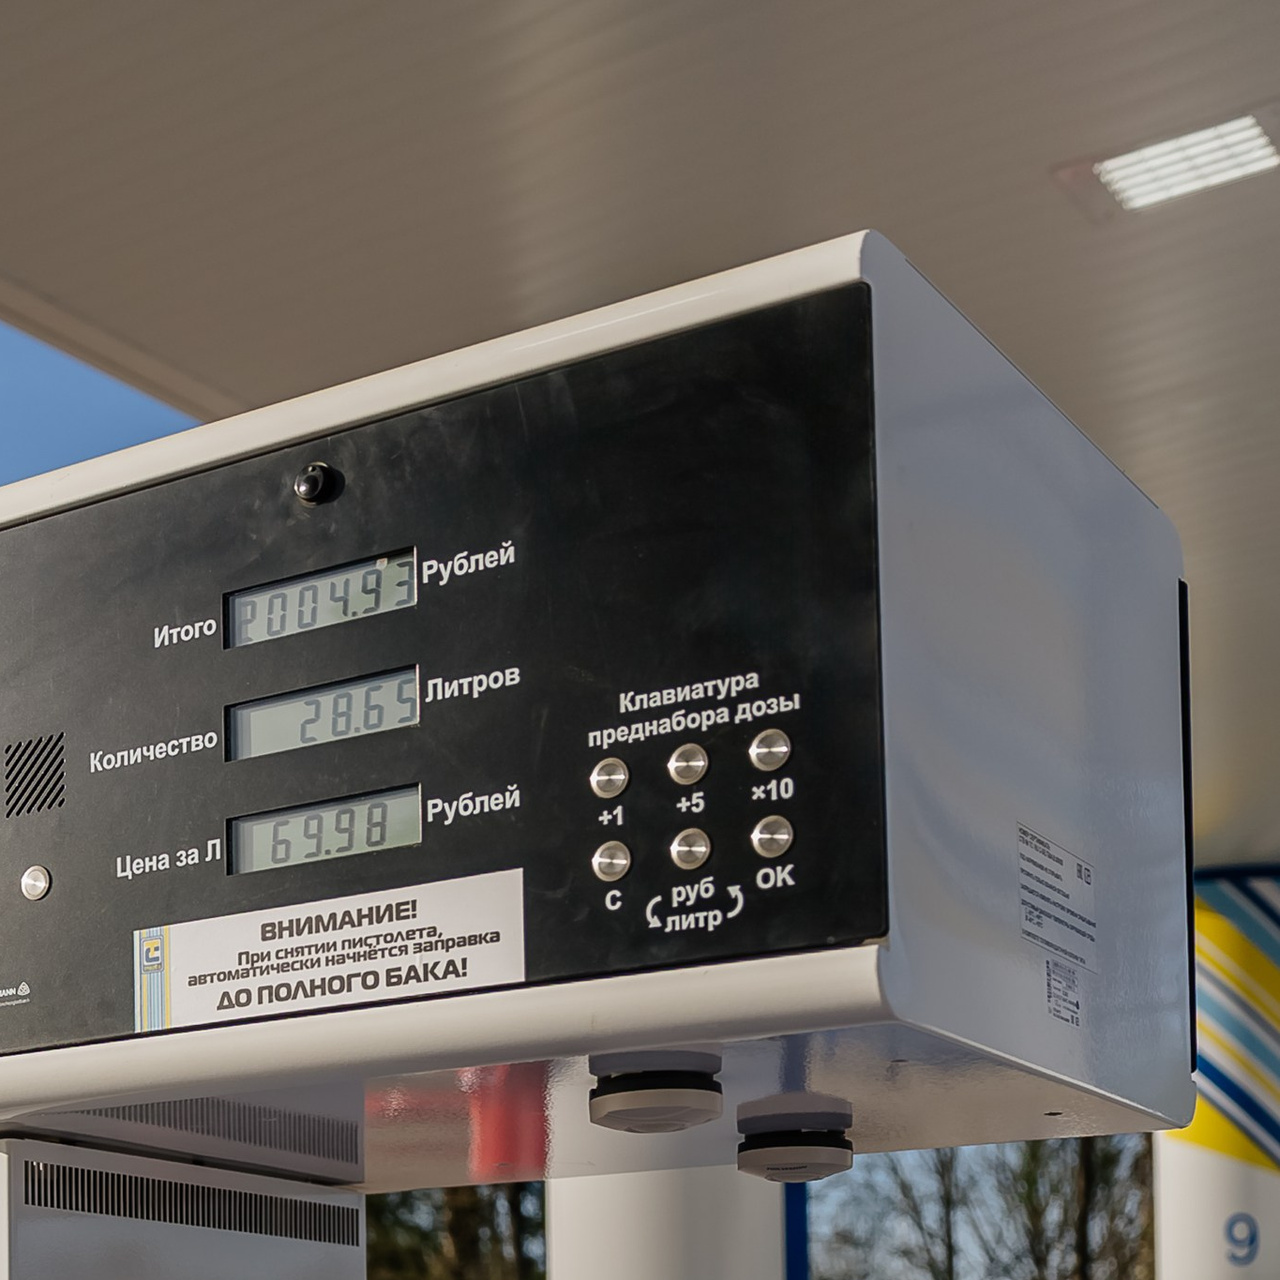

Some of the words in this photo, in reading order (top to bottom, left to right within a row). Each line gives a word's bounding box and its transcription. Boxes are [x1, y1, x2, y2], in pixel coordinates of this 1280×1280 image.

[422, 540, 516, 586] Рублей
[153, 618, 217, 649] Итого
[425, 667, 521, 703] Литров
[619, 671, 760, 714] Клавиатура
[300, 677, 416, 744] 28.65
[588, 707, 730, 750] преднабора
[734, 693, 801, 724] дозы
[89, 731, 218, 773] Количество
[427, 784, 521, 827] Рублей
[598, 805, 624, 826] +1
[676, 791, 705, 814] +5
[271, 802, 388, 865] 69.98
[116, 851, 170, 880] Цена
[175, 847, 200, 865] за
[205, 838, 221, 861] Л
[671, 876, 716, 908] руб
[260, 899, 418, 942] ВНИМАНИЕ!
[664, 908, 723, 933] литр
[187, 954, 322, 987] автоматически
[324, 941, 409, 969] начнётся
[412, 929, 501, 958] заправка
[237, 949, 272, 970] При
[274, 940, 338, 963] снятии
[340, 925, 444, 952] пистолета,
[216, 987, 253, 1011] ДО
[257, 968, 381, 1006] ПОЛНОГО
[385, 957, 469, 988] БАКА!
[1222, 1211, 1261, 1268] 9
